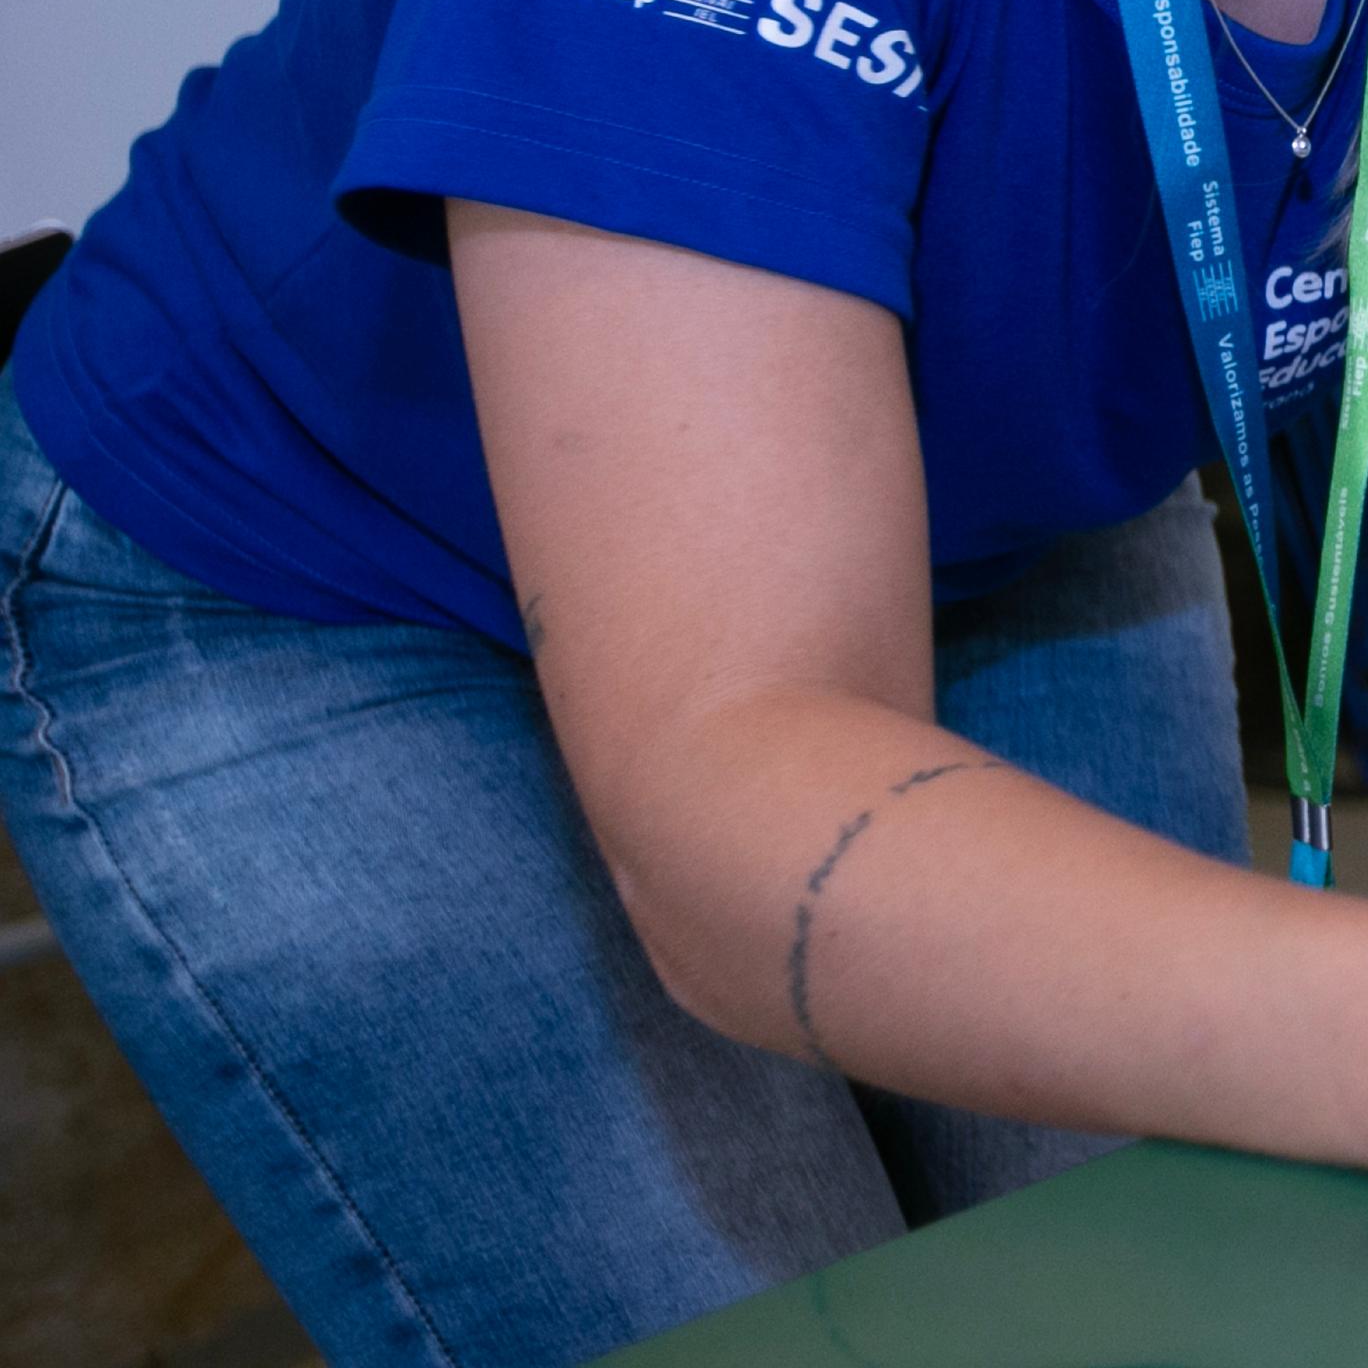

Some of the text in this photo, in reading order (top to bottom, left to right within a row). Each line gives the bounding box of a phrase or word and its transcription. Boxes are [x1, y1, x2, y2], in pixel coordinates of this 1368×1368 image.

[1187, 220, 1205, 262] Fiep
[1203, 181, 1225, 256] Sistema
[1218, 333, 1248, 468] Valorizamos
